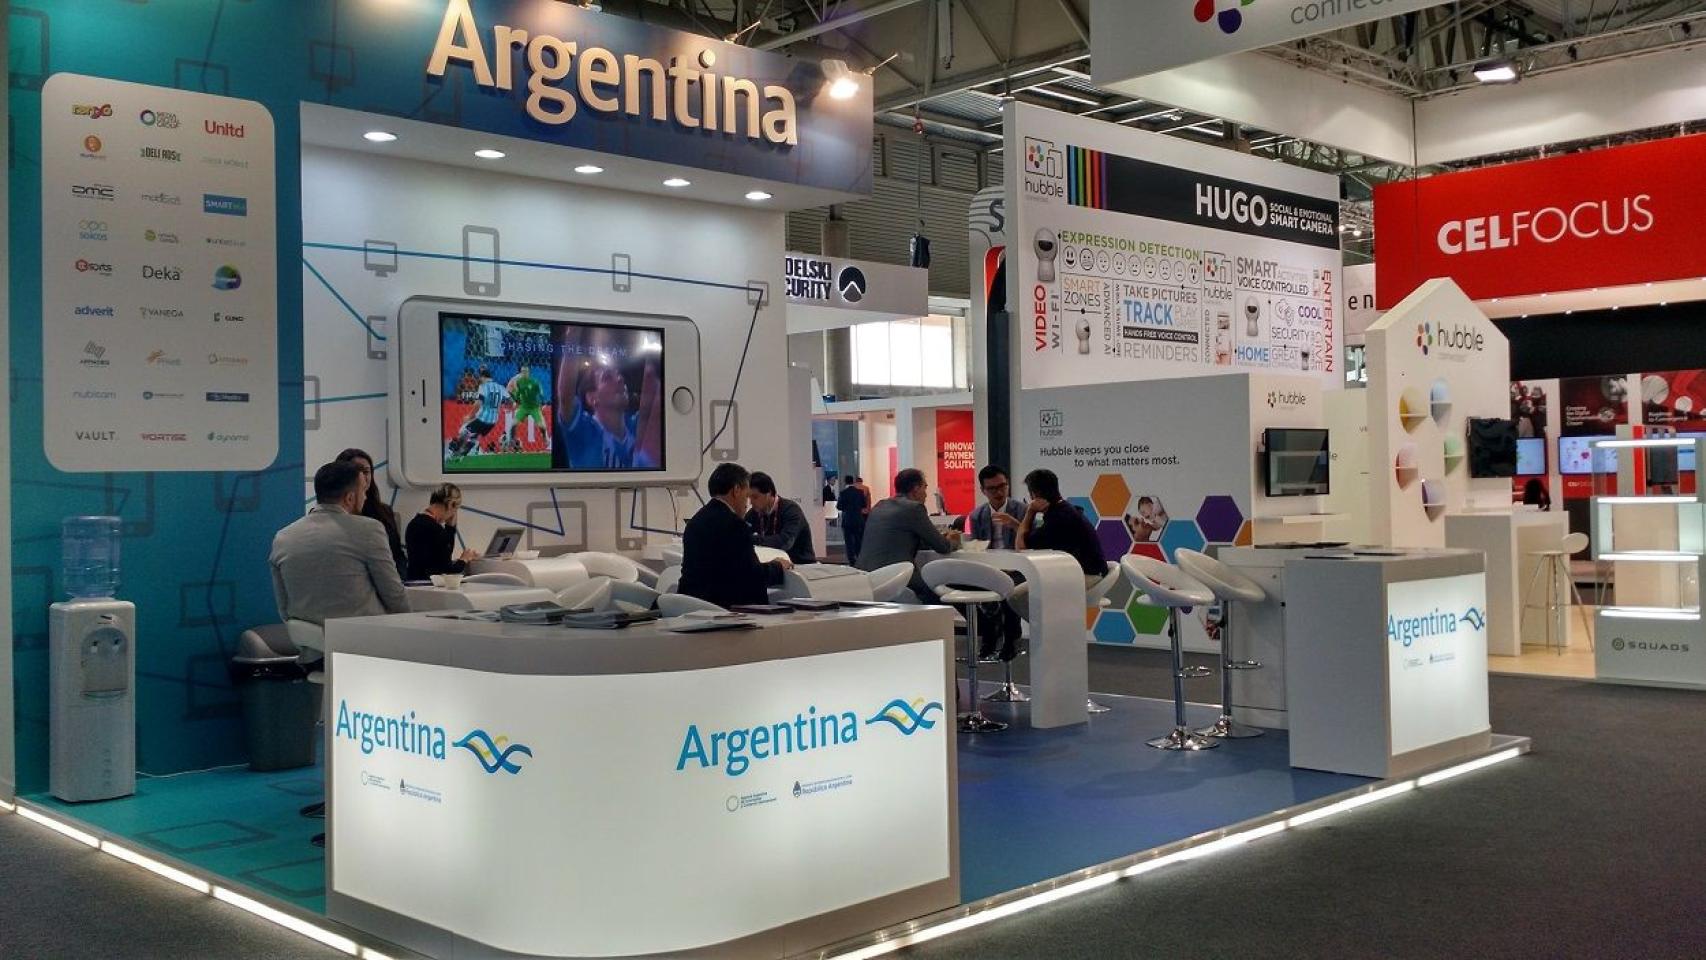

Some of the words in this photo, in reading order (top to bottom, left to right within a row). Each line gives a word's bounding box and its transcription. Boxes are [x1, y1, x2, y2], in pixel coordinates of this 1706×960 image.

[427, 0, 798, 145] Argentina
[1025, 178, 1064, 198] hubble
[1196, 183, 1268, 226] HUGO
[1269, 202, 1293, 215] SOCIAL
[1299, 209, 1333, 224] EMOTIONAL
[1269, 213, 1299, 229] SMART
[1300, 219, 1334, 236] CAMERA
[1436, 195, 1655, 257] CELFOCUS
[1062, 230, 1136, 251] EXPRESSION
[1139, 241, 1199, 261] DETECTION
[142, 265, 181, 281] Deka
[1237, 257, 1279, 279] SMART
[1064, 277, 1101, 293] SMART
[1123, 284, 1149, 299] TAKE
[1152, 286, 1198, 304] PICTURES
[1203, 284, 1232, 300] hubble
[1238, 278, 1260, 290] VOICE
[1261, 280, 1309, 296] CONTROLLED
[1064, 290, 1101, 307] ZONES
[1034, 284, 1047, 352] VIDEO
[1051, 294, 1060, 349] WI-FI
[1103, 283, 1112, 341] ADVANCED
[1123, 300, 1173, 326] TRACK
[1298, 305, 1323, 320] COOL
[1323, 270, 1333, 372] ENTERTAIN
[1157, 331, 1173, 340] VOICE
[1174, 333, 1198, 342] CONTROL
[1272, 326, 1310, 341] SECURITY
[1438, 321, 1484, 351] hubble
[499, 341, 554, 353] CHASING
[560, 344, 582, 355] THE
[1124, 342, 1198, 363] REMINDERS
[1237, 345, 1270, 362] HOME
[1272, 347, 1299, 361] GREAT
[1278, 391, 1306, 405] hubble
[1039, 428, 1064, 437] hubble
[1040, 446, 1072, 457] Hubble
[1074, 445, 1101, 458] keeps
[1103, 446, 1123, 456] you
[1124, 443, 1150, 454] close
[1074, 458, 1084, 468] to
[1086, 456, 1110, 468] what
[1111, 456, 1149, 467] matters
[1151, 455, 1180, 466] most.
[1387, 608, 1456, 647] Argentina
[1628, 641, 1690, 653] SQUADS
[336, 699, 446, 760] Argentina
[676, 705, 858, 776] Argentina
